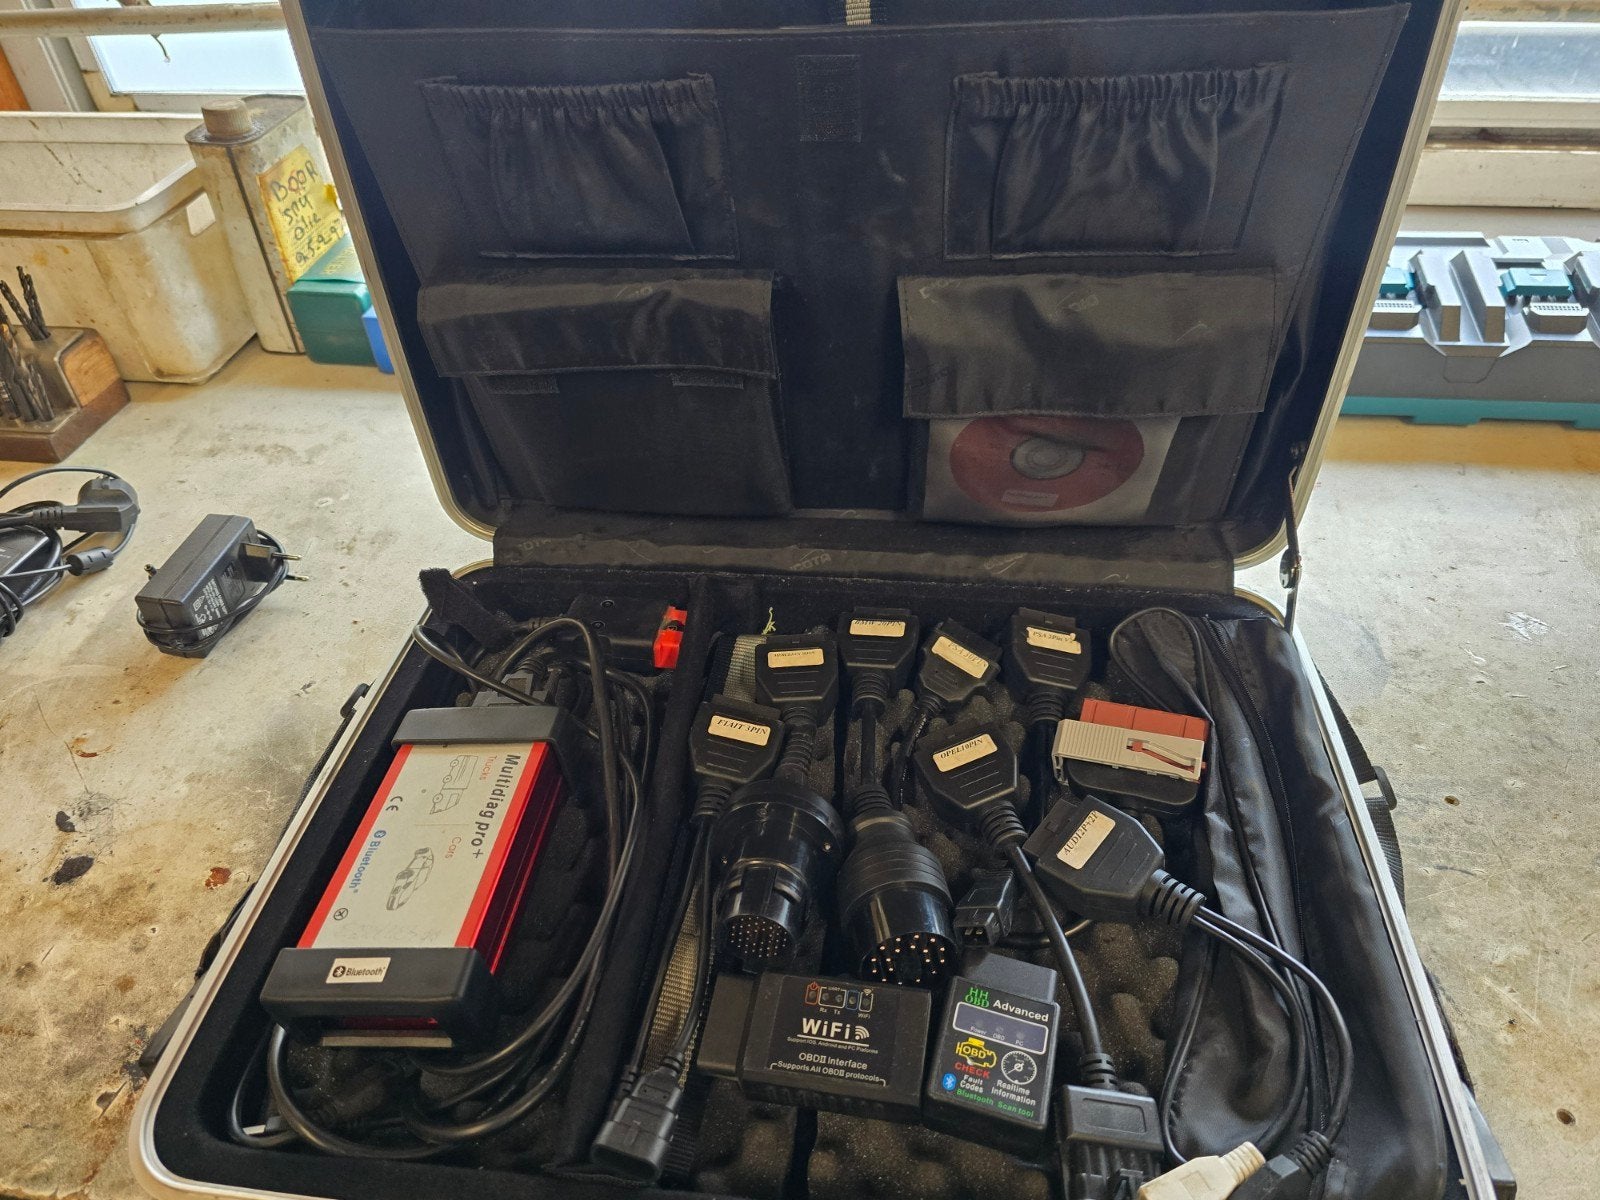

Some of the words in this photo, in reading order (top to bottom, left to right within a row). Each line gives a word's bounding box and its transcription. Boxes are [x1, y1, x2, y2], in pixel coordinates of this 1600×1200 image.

[940, 739, 983, 759] OPEL10PIN
[479, 755, 498, 780] Trucks
[478, 754, 521, 819] Multidiag
[445, 836, 462, 859] Cars
[993, 999, 1049, 1022] Advanced
[802, 1017, 851, 1040] WiFi
[777, 1060, 810, 1072] Supports
[810, 1065, 821, 1073] All
[845, 1070, 880, 1082] protocols
[828, 1056, 868, 1070] Interface
[954, 1061, 991, 1079] CHECK
[960, 1080, 984, 1093] Codes
[963, 1074, 983, 1085] Fault
[996, 1079, 1030, 1096] Realtime
[991, 1086, 1036, 1106] Information
[997, 1100, 1017, 1113] Scan
